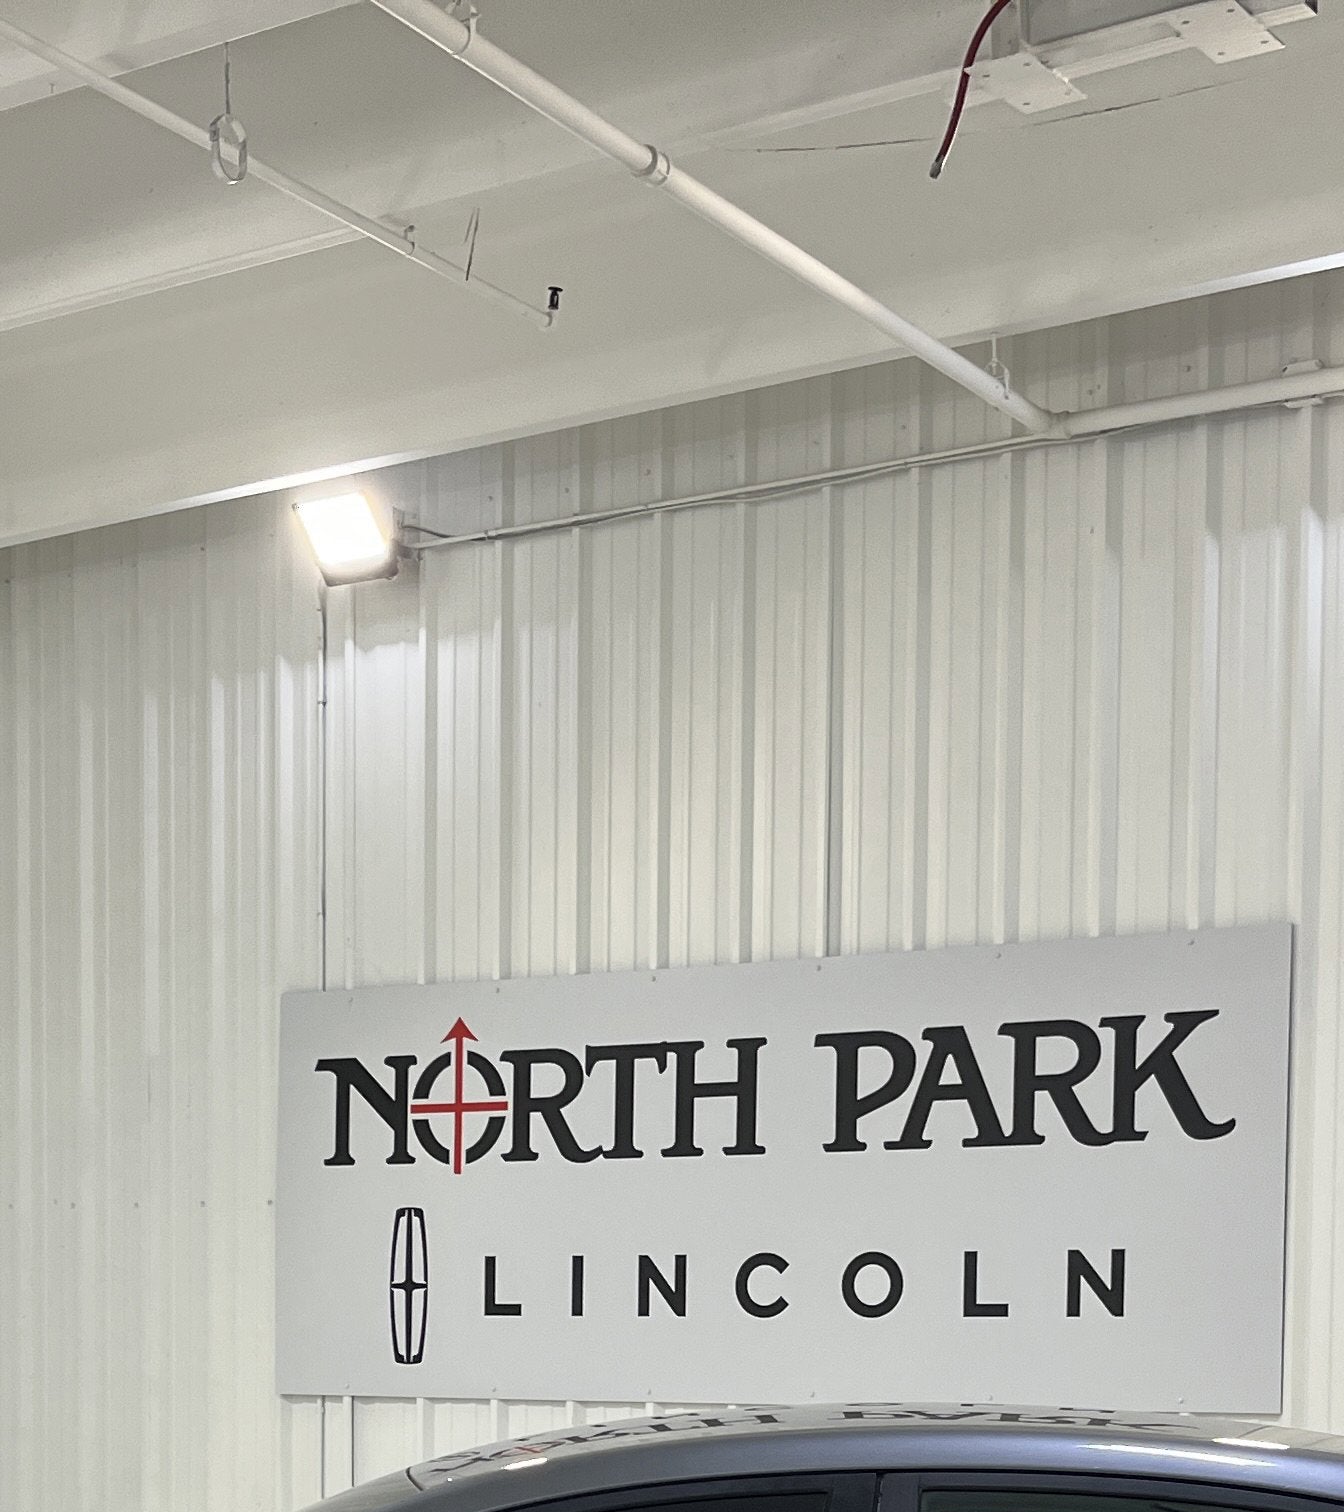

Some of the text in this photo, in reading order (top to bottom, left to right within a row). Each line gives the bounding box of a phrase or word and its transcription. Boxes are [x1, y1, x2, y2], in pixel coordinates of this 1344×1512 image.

[313, 1008, 1238, 1168] NORTH PARK
[482, 1247, 1127, 1320] LINCOLN
